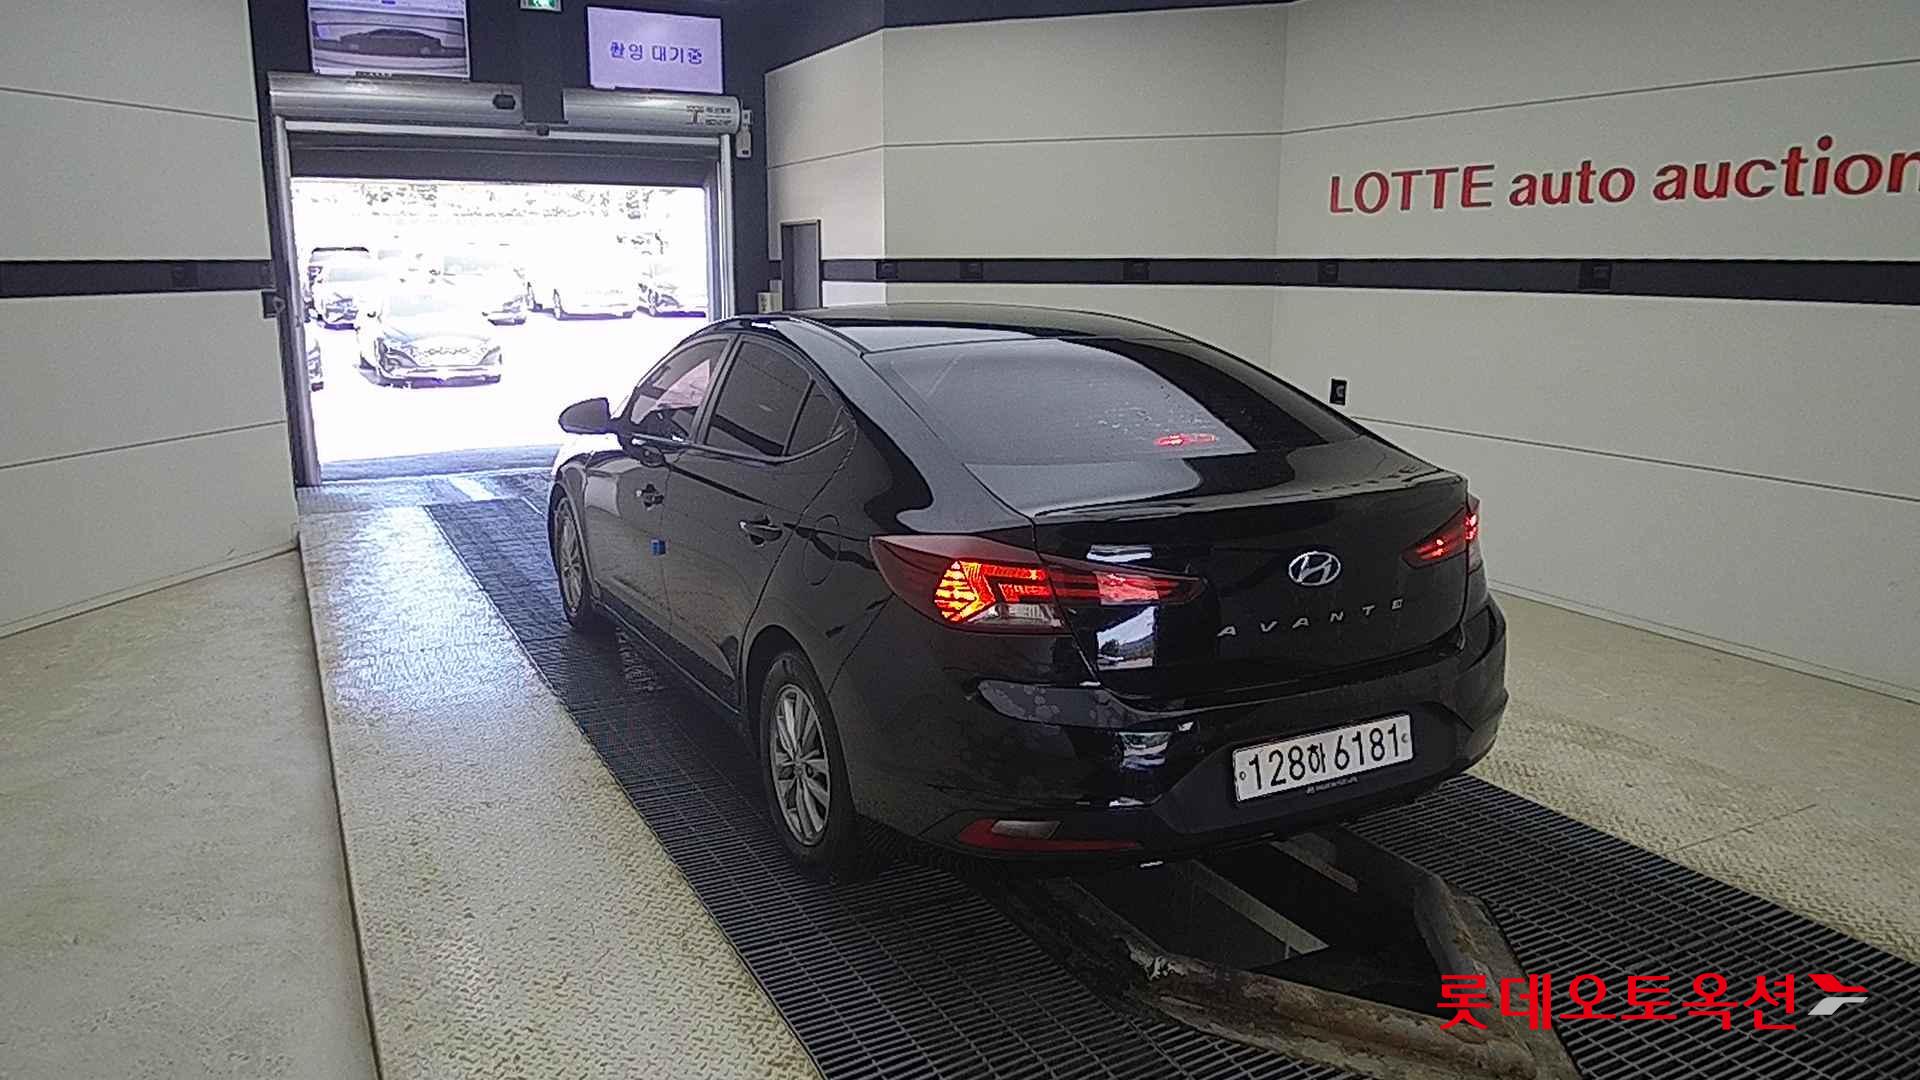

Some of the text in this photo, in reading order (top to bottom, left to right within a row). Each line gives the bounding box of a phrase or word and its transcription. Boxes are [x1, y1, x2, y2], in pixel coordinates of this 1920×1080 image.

[1330, 165, 1496, 214] LOTTE
[1509, 160, 1636, 207] auto
[1217, 599, 1403, 637] AVANTE
